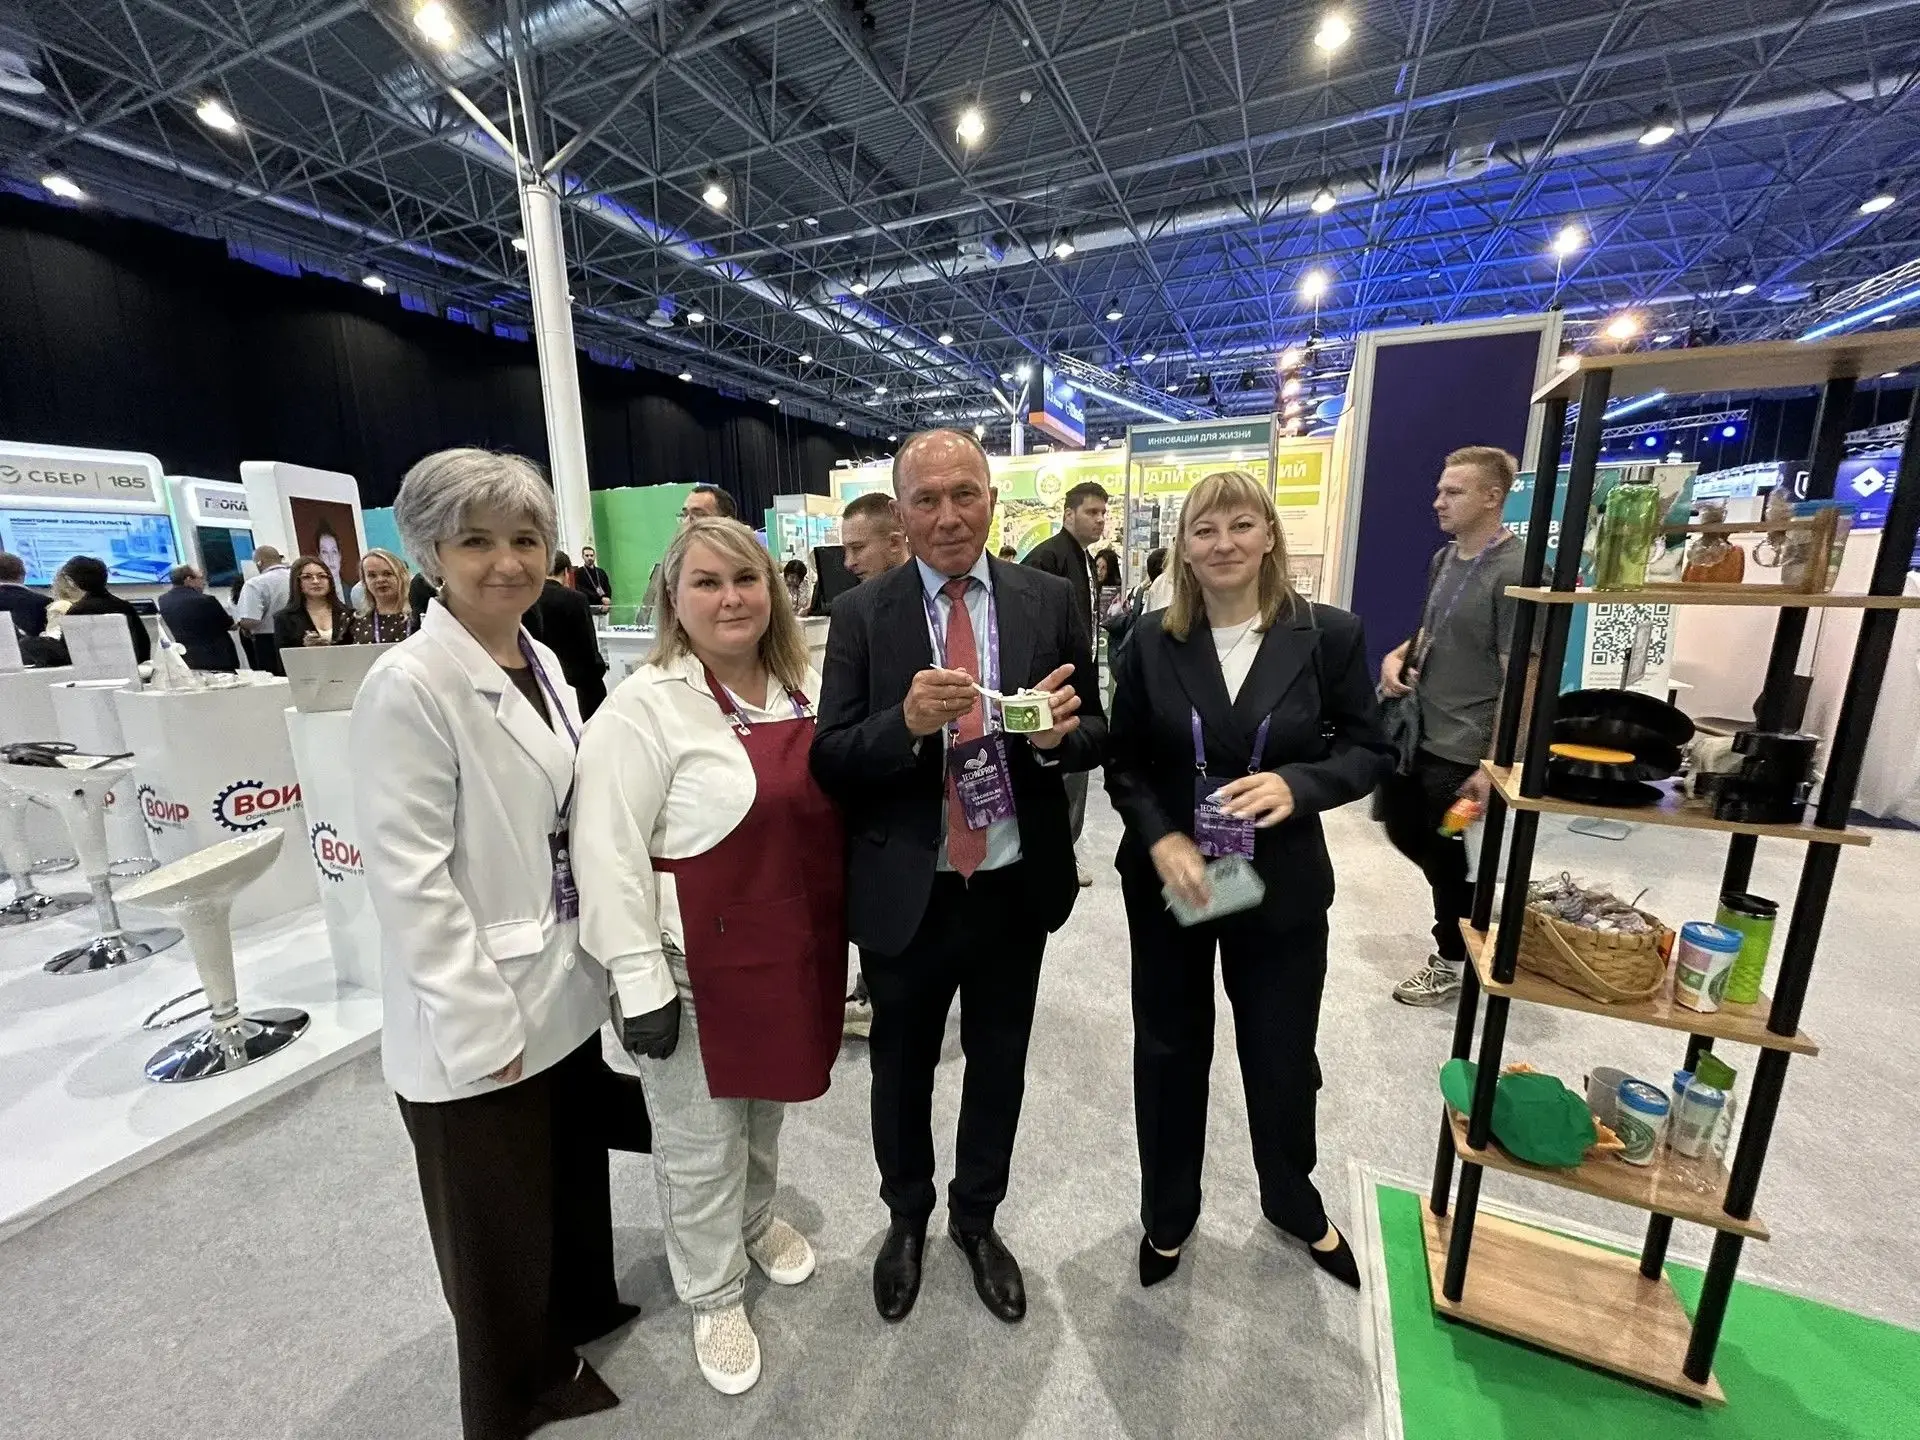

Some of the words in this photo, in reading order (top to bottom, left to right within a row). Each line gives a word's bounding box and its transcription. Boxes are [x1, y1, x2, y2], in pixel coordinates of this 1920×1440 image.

[1148, 434, 1199, 446] ИННОВАЦИИ
[1200, 432, 1218, 443] ДЛЯ
[1219, 430, 1251, 440] ЖИЗНИ
[28, 470, 86, 486] СБЕР
[107, 476, 146, 489] 185
[961, 764, 998, 782] TECHNOPROM
[234, 783, 303, 816] ВОИ
[146, 798, 190, 822] ВОИР
[245, 806, 285, 821] Основано
[321, 838, 364, 868] ВОИ
